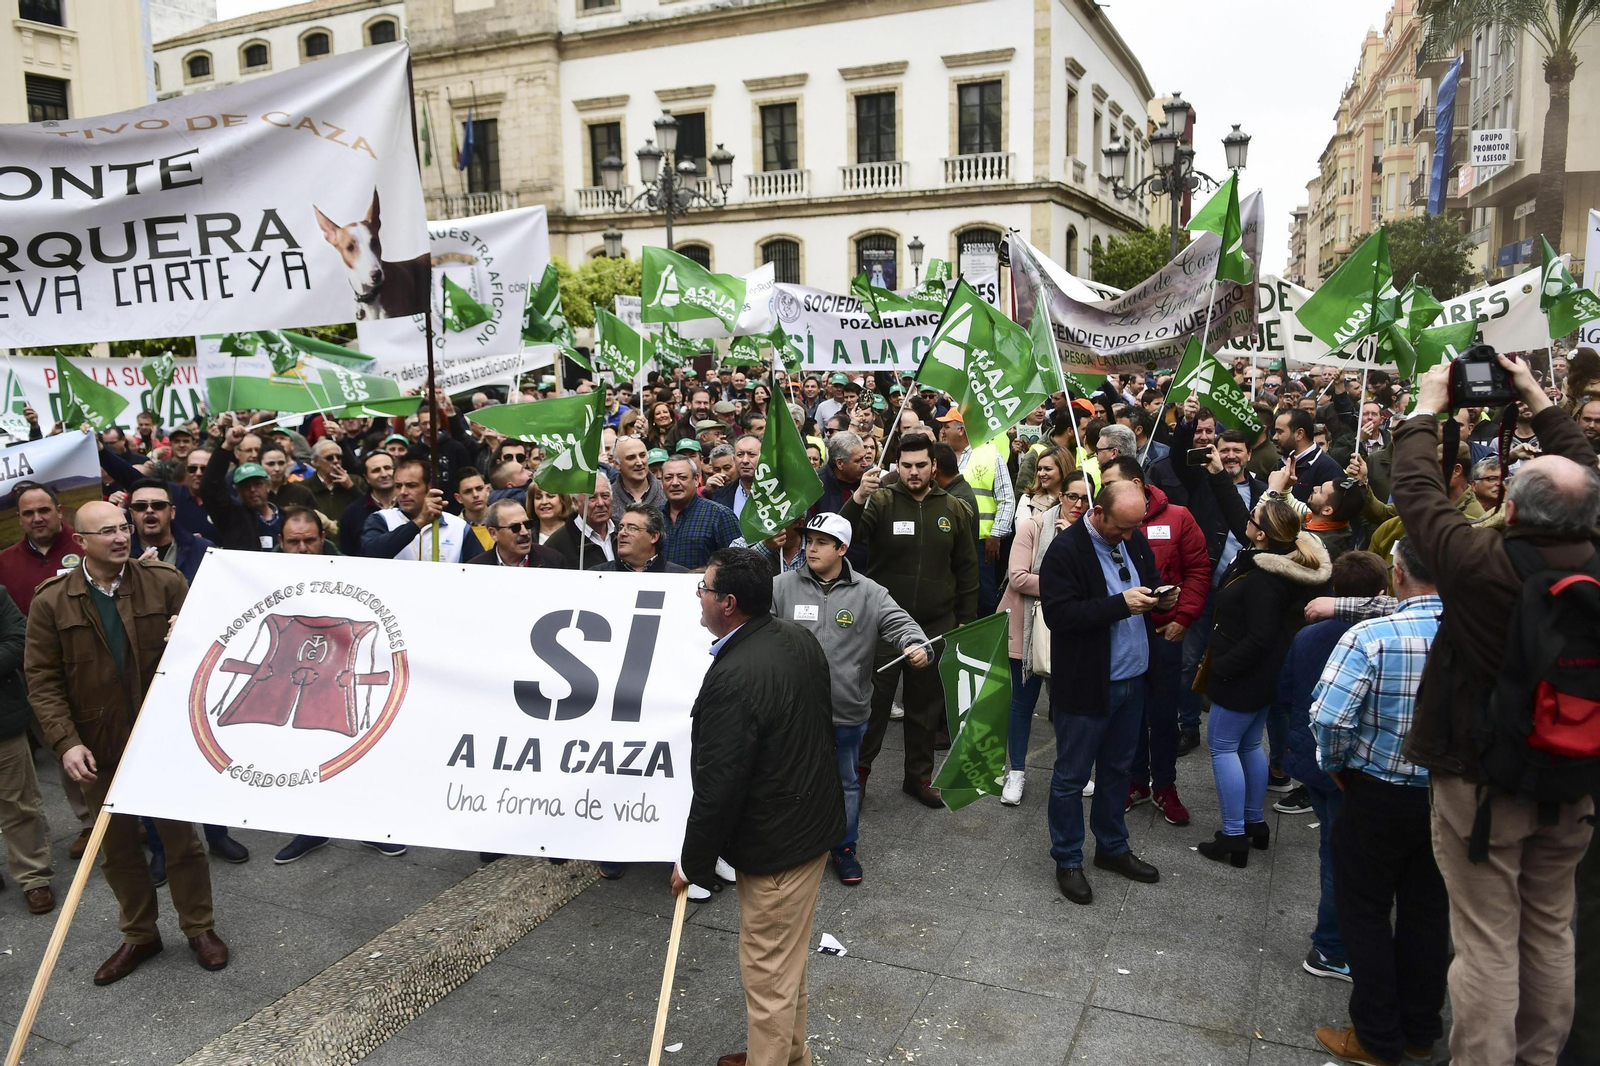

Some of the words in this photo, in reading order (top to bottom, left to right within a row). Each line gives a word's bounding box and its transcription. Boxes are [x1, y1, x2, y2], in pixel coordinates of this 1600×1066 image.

[186, 114, 248, 132] DE
[261, 111, 377, 160] CAZA
[1473, 143, 1510, 153] PROMOTOR
[1480, 133, 1503, 142] GRUPO
[1482, 153, 1507, 162] ASESOR
[0, 147, 203, 201] ONTE
[963, 243, 971, 255] 33
[1153, 272, 1172, 292] de
[682, 297, 736, 322] Córdoba
[683, 286, 736, 312] ASAJA
[804, 294, 868, 314] SOCIEDA
[840, 312, 943, 331] POZOBLANC
[1145, 327, 1169, 341] LO
[1173, 285, 1244, 336] NUESTRO
[832, 340, 851, 364] A
[860, 339, 899, 364] LA
[1111, 344, 1181, 367] NATURALEZA
[1211, 391, 1262, 432] Córdoba
[1502, 429, 1511, 464] Canon
[755, 463, 792, 520] SAJA
[220, 582, 305, 644] MONTEROS
[309, 580, 405, 650] TRADICIONALES
[1558, 656, 1600, 667] Canon
[446, 733, 475, 769] A
[492, 735, 542, 773] LA
[559, 739, 675, 779] CAZA
[230, 763, 314, 788] CÓRDOBA
[446, 782, 487, 813] Una
[497, 787, 566, 818] forma
[574, 788, 604, 821] de
[613, 792, 660, 824] vida
